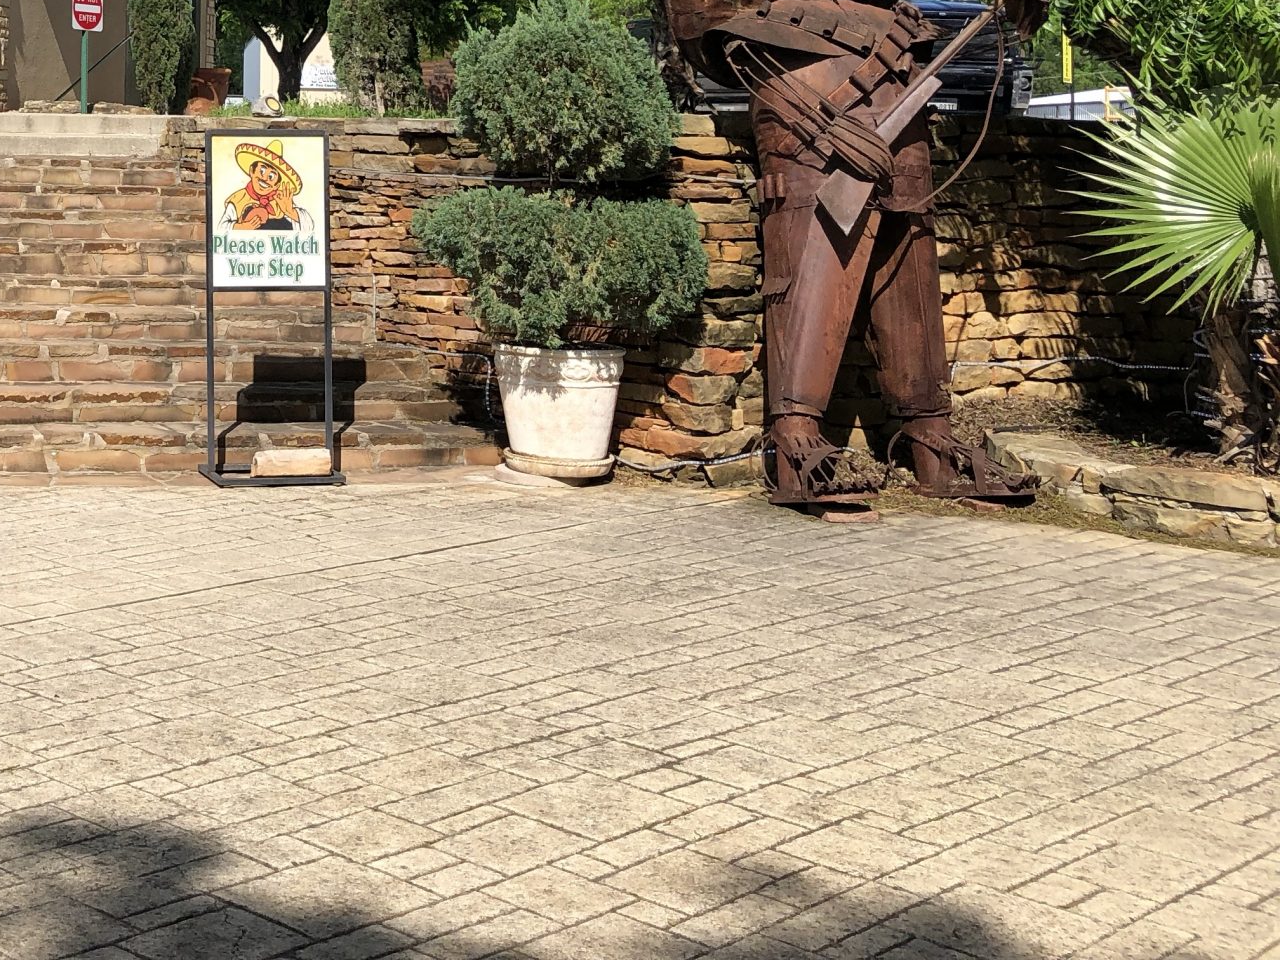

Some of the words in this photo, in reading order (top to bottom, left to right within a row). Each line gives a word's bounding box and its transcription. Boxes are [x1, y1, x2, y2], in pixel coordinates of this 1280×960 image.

[78, 14, 96, 22] ENTER
[212, 231, 266, 255] Please
[270, 231, 320, 255] Watch
[228, 257, 264, 278] Your
[268, 257, 304, 282] Step
